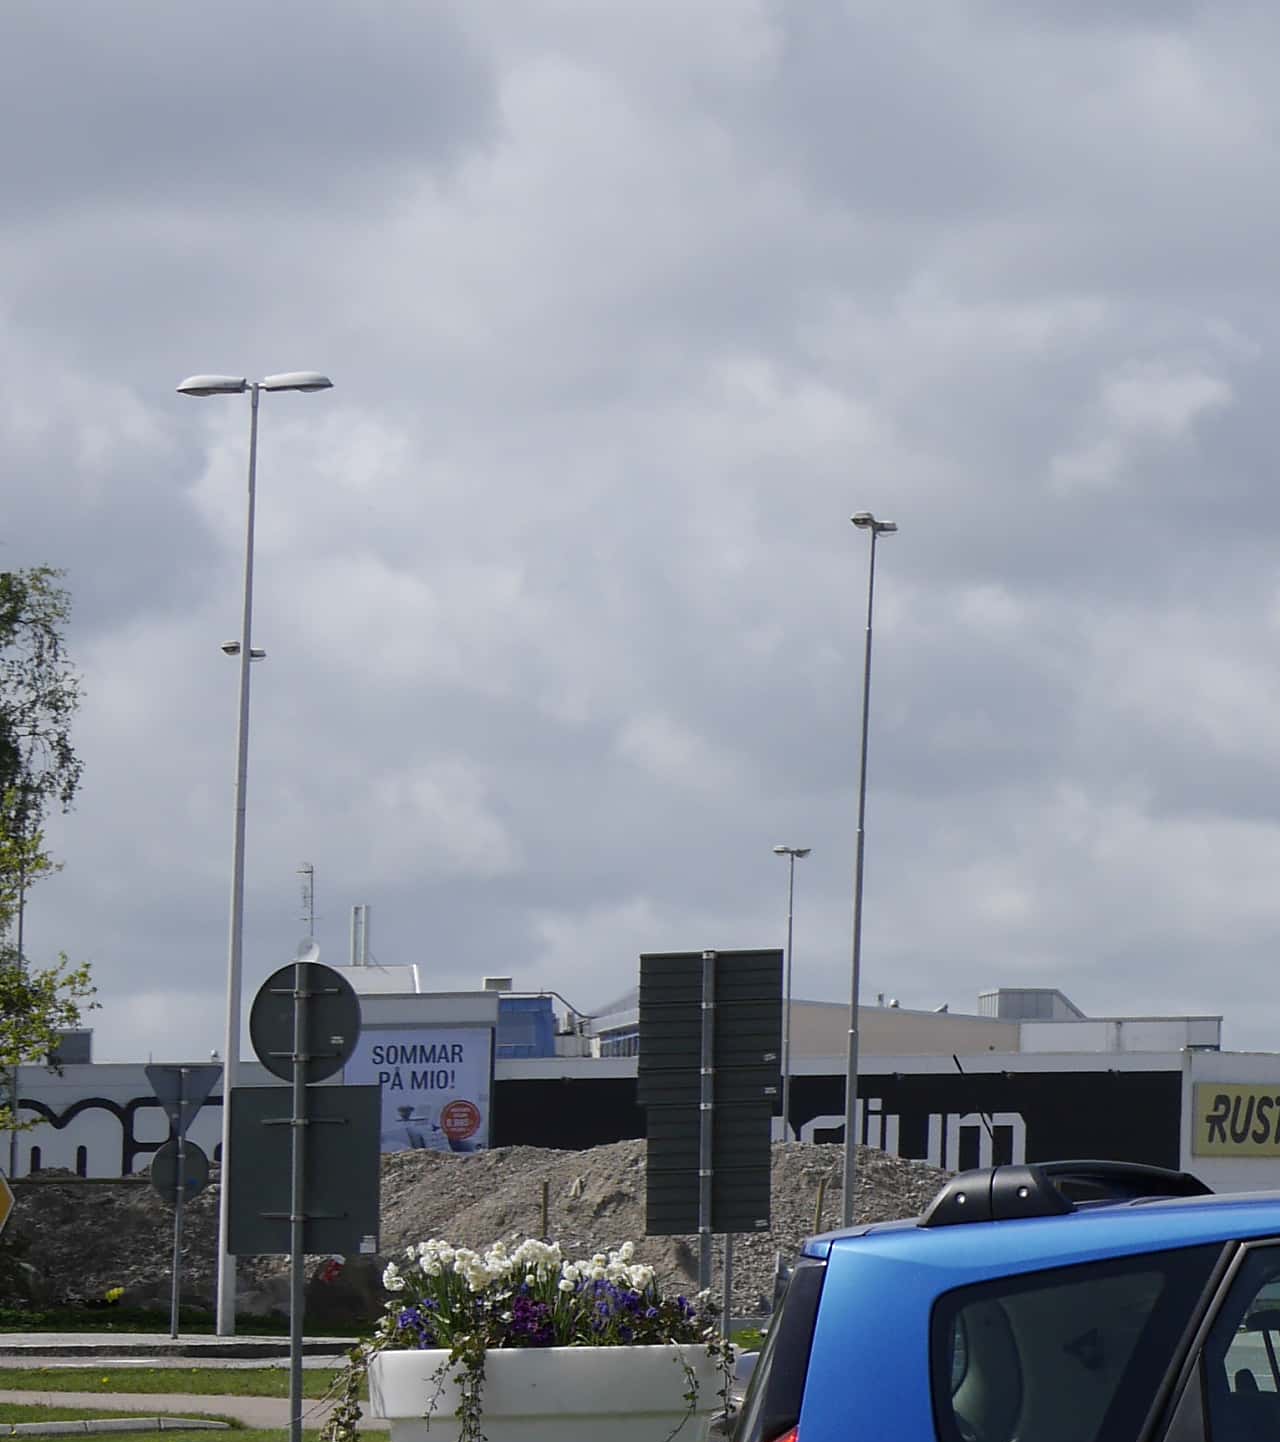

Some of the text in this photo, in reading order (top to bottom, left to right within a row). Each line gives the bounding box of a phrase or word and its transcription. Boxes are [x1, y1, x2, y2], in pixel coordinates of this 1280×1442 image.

[372, 1044, 464, 1065] SOMMAR
[379, 1066, 455, 1090] PÅ MIO!
[771, 1098, 1027, 1172] dium
